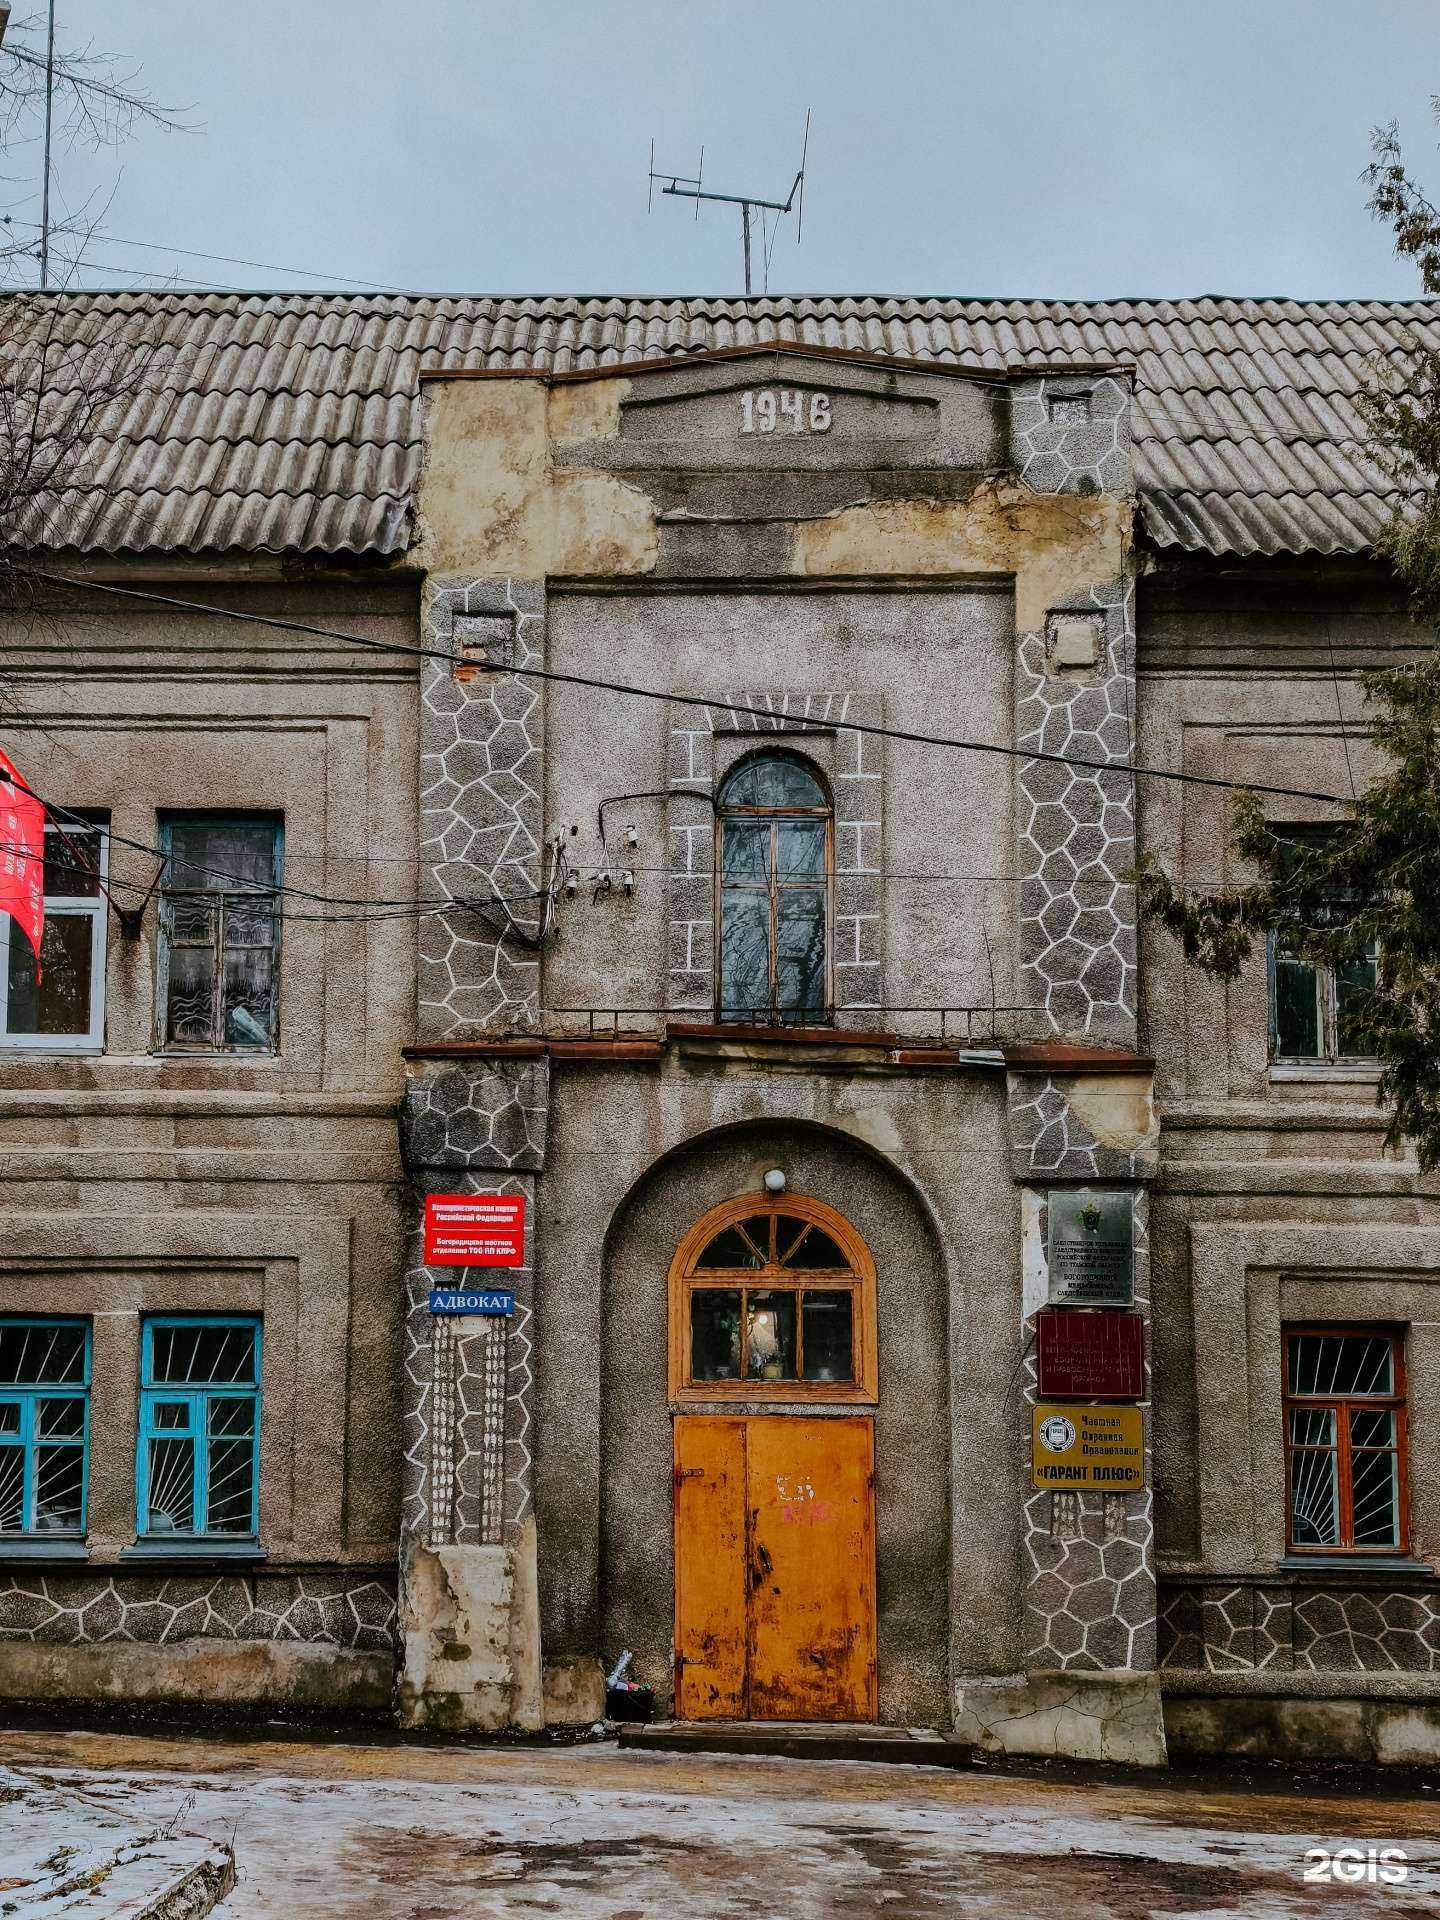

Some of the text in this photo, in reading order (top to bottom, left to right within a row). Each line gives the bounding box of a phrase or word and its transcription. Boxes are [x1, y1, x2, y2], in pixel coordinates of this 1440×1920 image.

[741, 391, 832, 433] 1946
[433, 1296, 511, 1309] АДВОКАТ
[1081, 1415, 1121, 1427] Частная
[1082, 1430, 1123, 1443] Охранная
[1037, 1466, 1140, 1480] «ГАРАНТ ПЛЮС»
